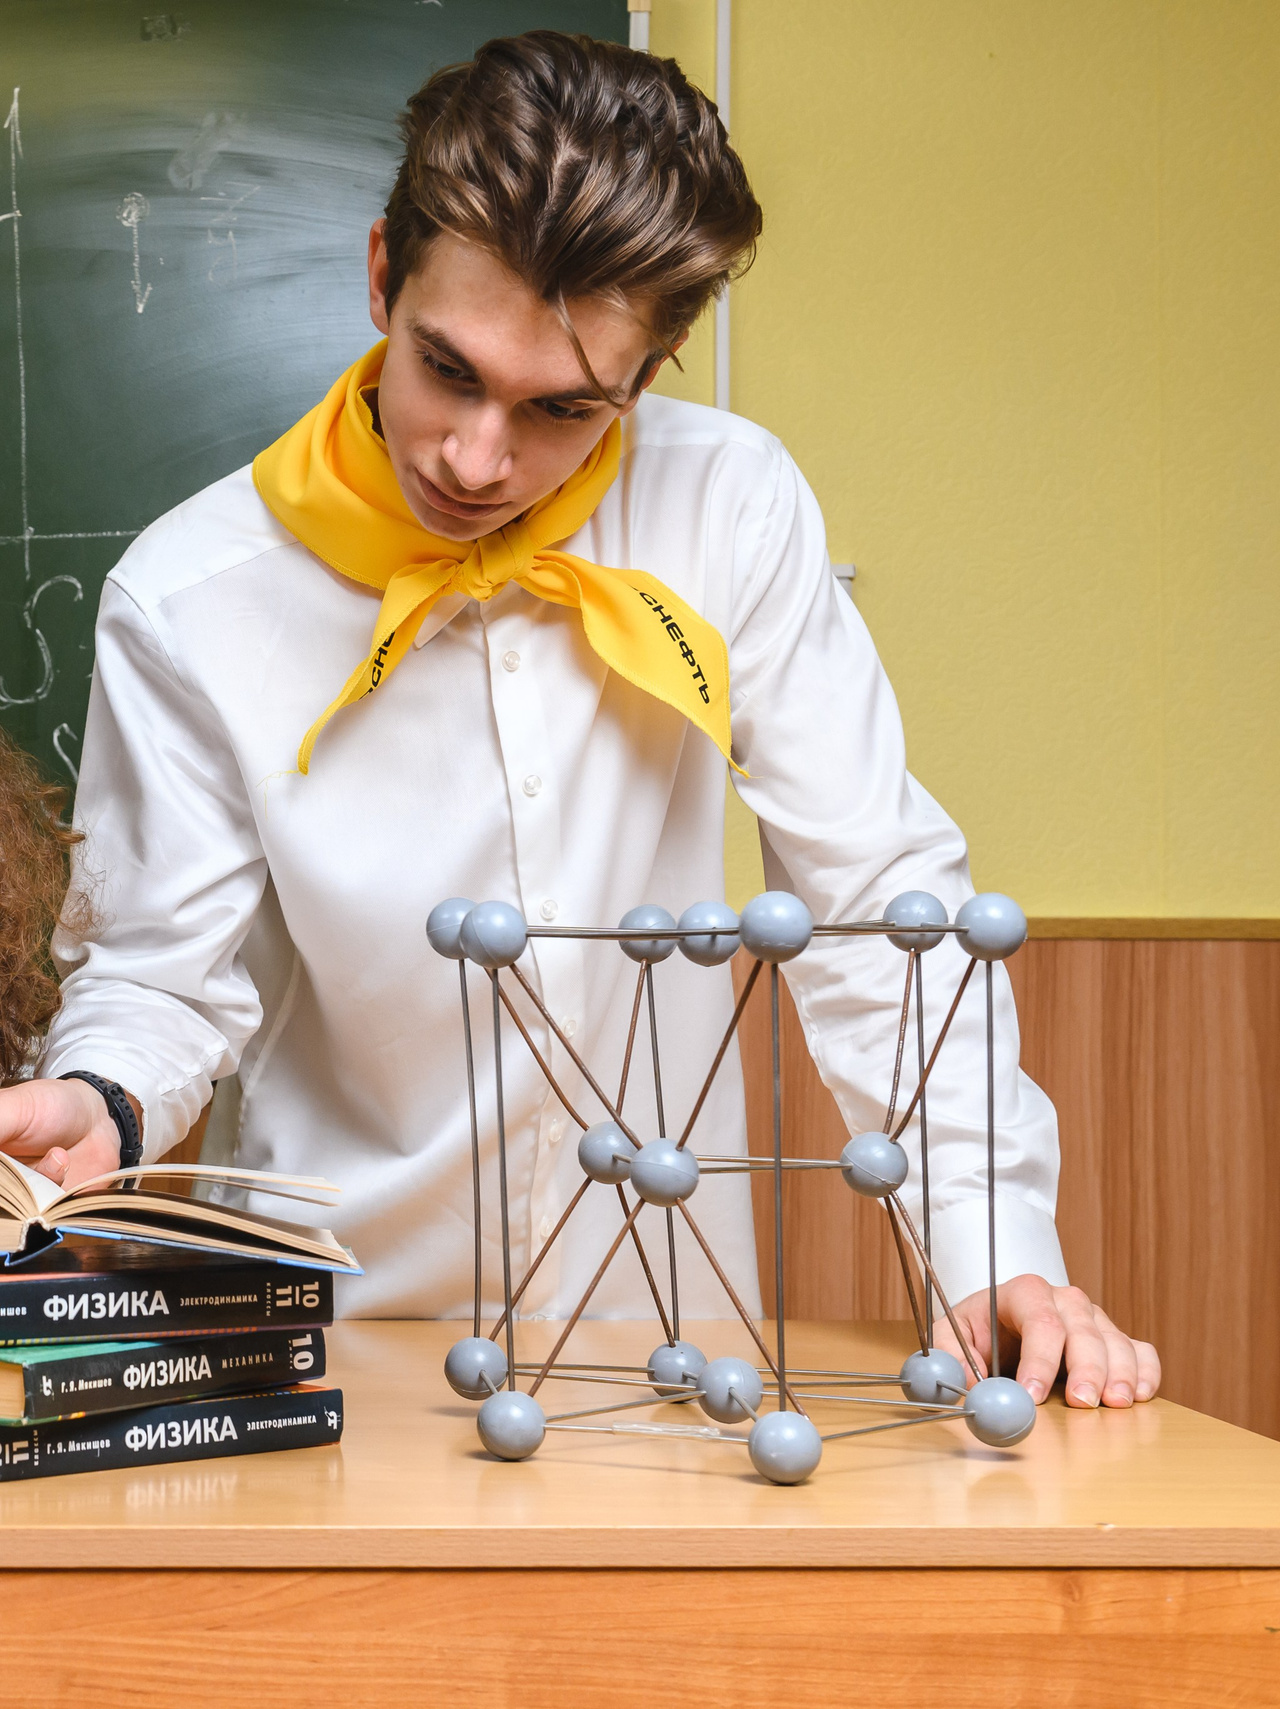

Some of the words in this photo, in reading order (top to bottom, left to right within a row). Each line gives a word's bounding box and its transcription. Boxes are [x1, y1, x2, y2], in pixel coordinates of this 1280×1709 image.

[632, 586, 710, 704] СНЕФТЬ
[43, 1290, 170, 1321] ФИЗИКА
[179, 1294, 259, 1307] ЭЛЕКТРОДИНАМИКА
[276, 1285, 292, 1307] 11
[302, 1281, 320, 1308] 10
[292, 1333, 315, 1371] 10
[123, 1354, 212, 1391] ФИЗИКА
[222, 1352, 274, 1369] МЕХАНИКА
[68, 1438, 111, 1453] Мякишев
[124, 1415, 239, 1452] ФИЗИКА
[246, 1414, 317, 1431] ЭЛЕКТРОДИНАМИКА
[12, 1440, 30, 1465] 11
